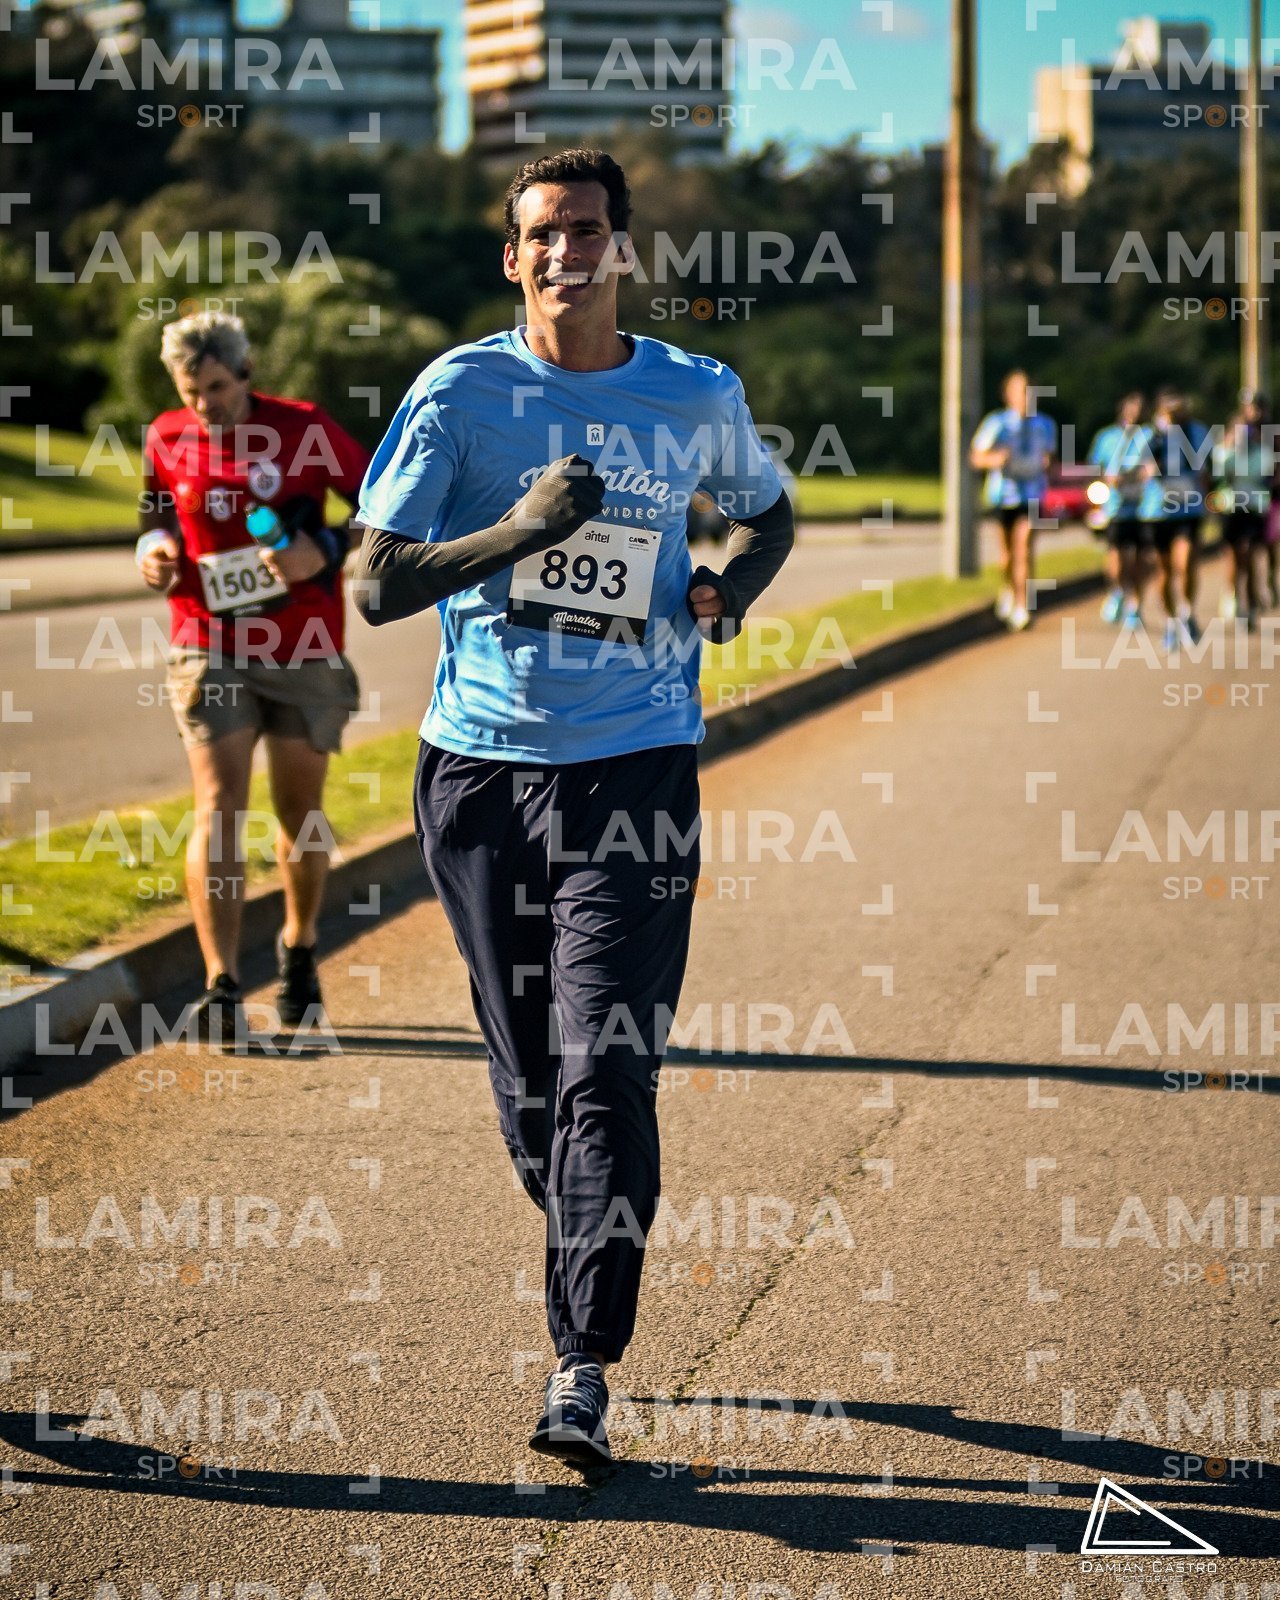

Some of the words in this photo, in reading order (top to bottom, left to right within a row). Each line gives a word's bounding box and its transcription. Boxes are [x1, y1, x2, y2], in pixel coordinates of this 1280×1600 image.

[518, 465, 671, 503] atón
[584, 530, 610, 544] antel
[208, 563, 275, 600] 1503
[540, 550, 628, 601] 893
[553, 611, 601, 630] Maratón
[556, 625, 596, 635] MONTEVIDEO
